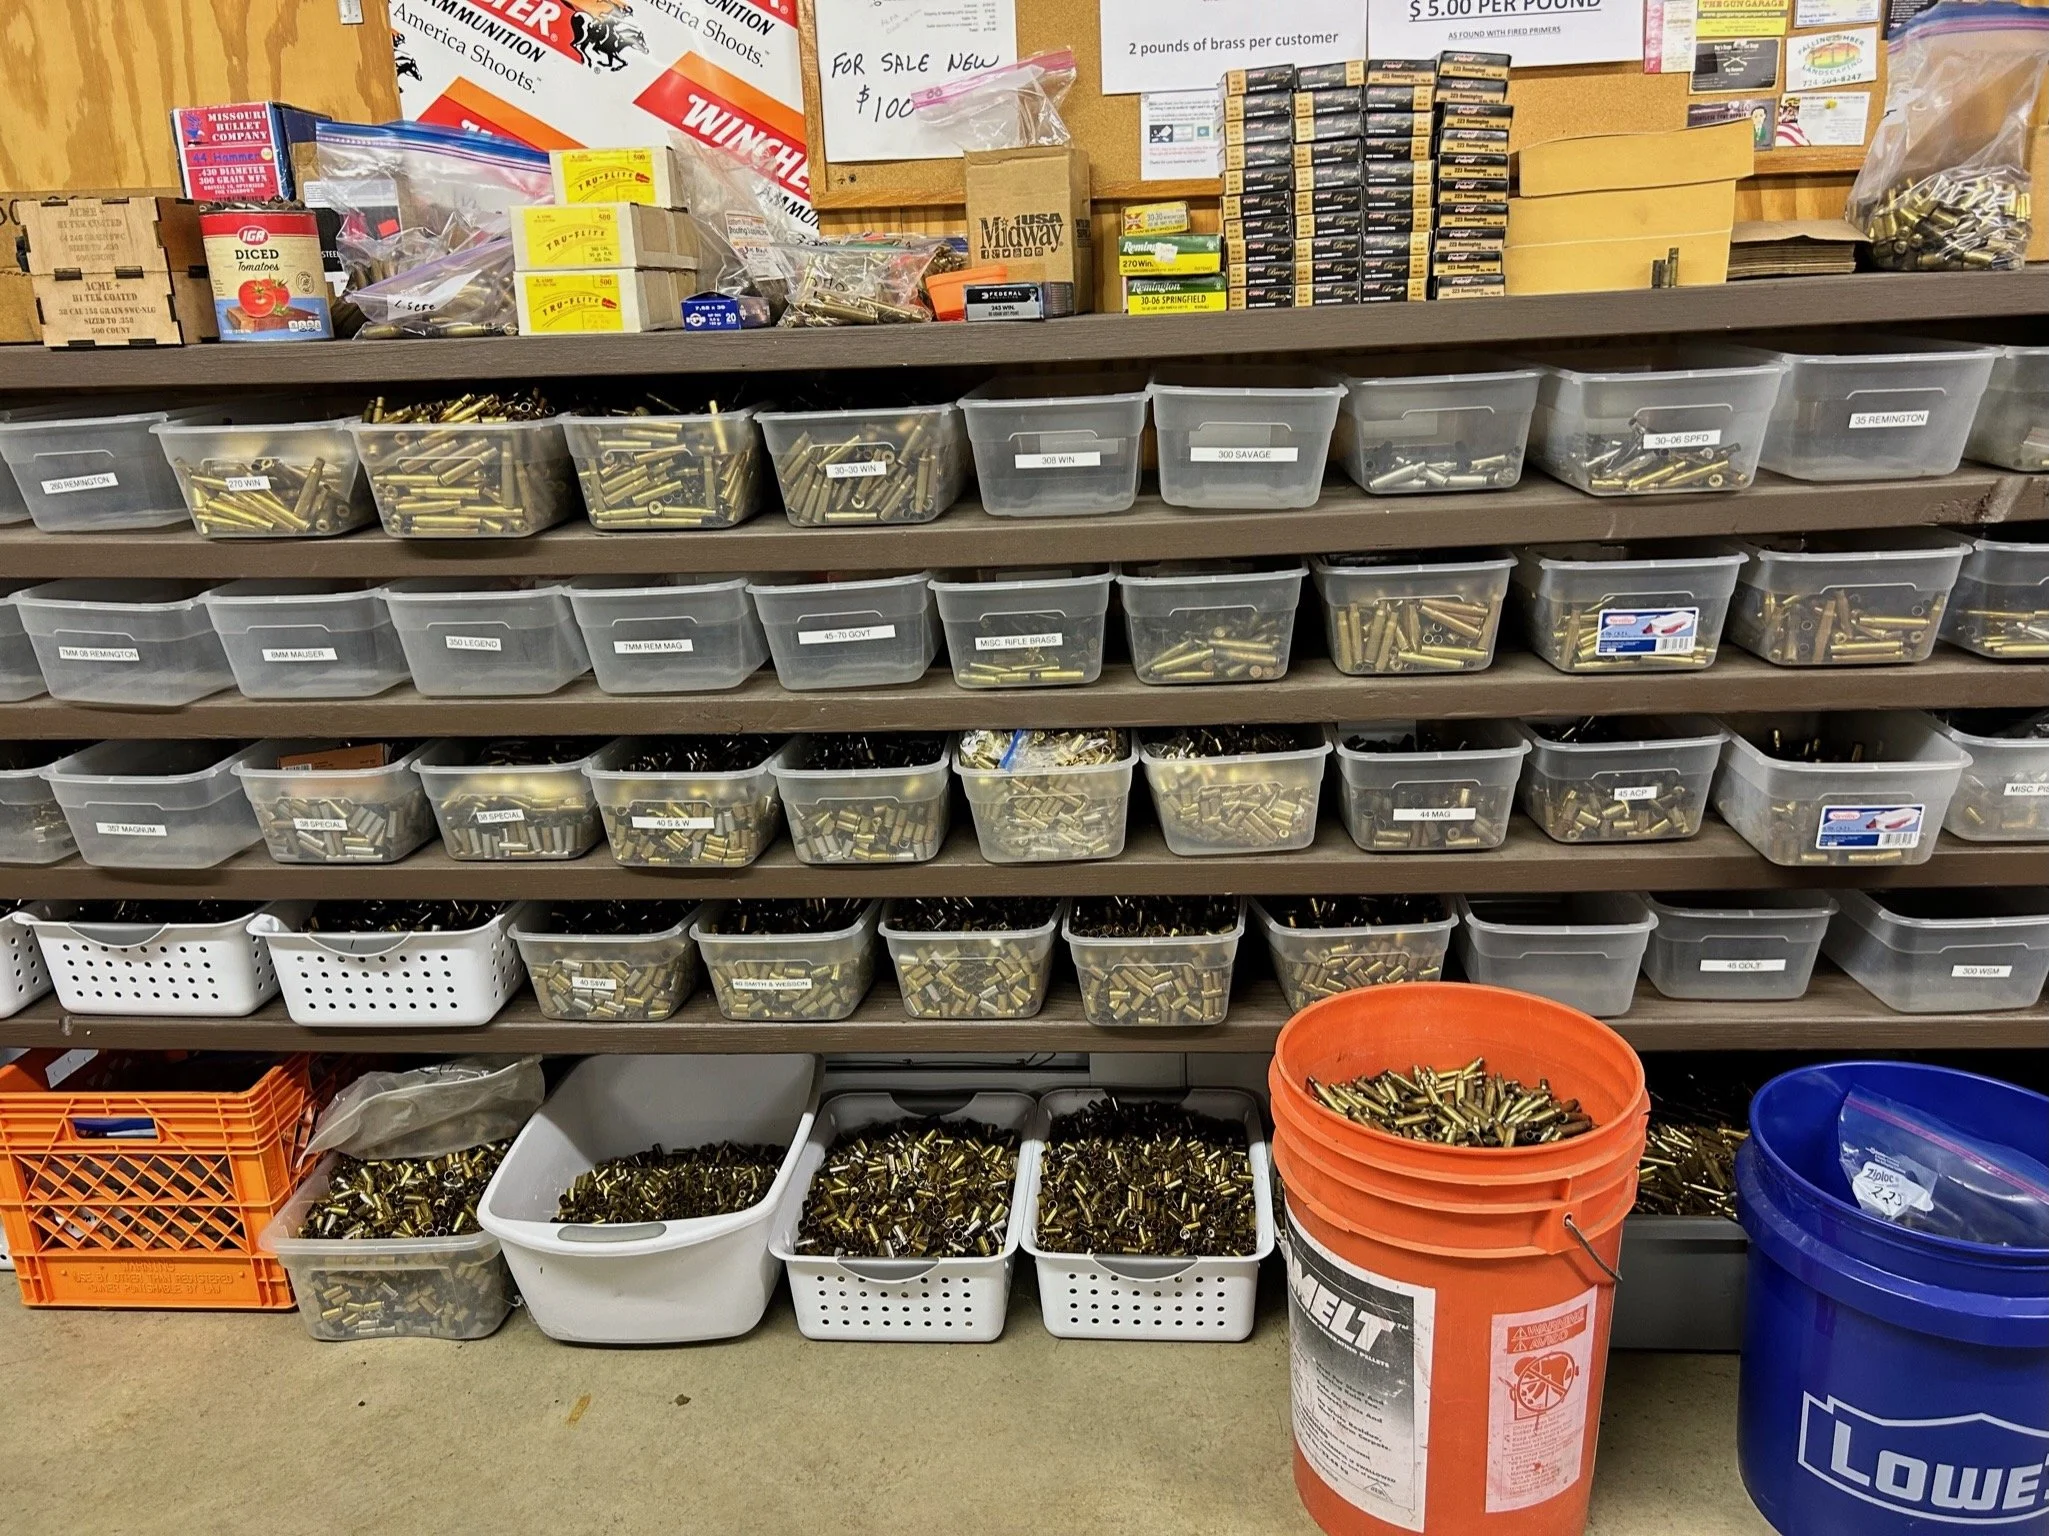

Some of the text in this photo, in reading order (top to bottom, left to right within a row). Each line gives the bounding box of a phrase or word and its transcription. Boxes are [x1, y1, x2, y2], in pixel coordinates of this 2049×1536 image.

[1428, 0, 1472, 16] 5.00
[1478, 0, 1517, 14] PER
[1746, 0, 1784, 8] GARAGE
[423, 0, 546, 62] MMUNITION
[1459, 30, 1485, 38] FOUND
[1487, 28, 1506, 37] WITH
[1507, 27, 1528, 36] FIRED
[1529, 26, 1561, 34] PRIMERS
[394, 3, 536, 94] America Shoots.
[702, 19, 763, 68] Shoots.
[1129, 31, 1339, 57] 2 pounds of brass per customer
[832, 52, 999, 78] FOR SALE NEW
[208, 111, 267, 122] MISSOURI
[216, 121, 260, 131] BULLET
[212, 131, 268, 141] COMPANY
[193, 152, 260, 162] 44 Hammer
[219, 166, 265, 175] DIAMETER
[217, 175, 245, 184] GRAIN
[598, 213, 611, 221] 500
[1015, 212, 1062, 226] USA
[242, 230, 266, 241] IGA
[546, 229, 606, 251] TRU-FLITE
[979, 217, 1064, 253] Midway
[235, 249, 279, 260] DICED
[238, 261, 280, 272] Tomatoes
[84, 282, 113, 291] ACME
[1132, 282, 1180, 294] Remington
[104, 293, 138, 301] COATED
[1141, 294, 1206, 305] 30-06 SPRINGFIELD
[542, 297, 599, 317] TRU-FLITE
[84, 317, 105, 325] SIZED
[106, 317, 117, 325] TO
[725, 312, 737, 323] 20
[106, 326, 130, 334] COUNT
[1855, 414, 1925, 425] 35 REMINGTON
[1654, 433, 1709, 445] 30-06 SPFD
[1218, 449, 1272, 459] 300 SAVAGE
[1041, 455, 1075, 465] 308 WIN
[834, 464, 877, 475] 30-30 WIN
[64, 475, 110, 488] REMINGTON
[228, 478, 261, 489] 270 WIN
[824, 629, 872, 640] 45-70 GOVT
[448, 638, 498, 649] 350 LEGEND
[624, 641, 683, 652] 7MM REM MAG
[980, 635, 1057, 648] MISC. RIFLE BRASS
[61, 648, 137, 660] 7MM 08 REMINGTON
[271, 649, 325, 659] 8MM MAUSER
[1618, 789, 1648, 798] 45 ACP
[2010, 785, 2035, 793] MISC.
[489, 811, 521, 821] SPECIAL
[1432, 810, 1451, 819] MAG
[299, 820, 343, 829] 38 SPECIAL
[667, 819, 673, 827] S
[107, 825, 157, 834] 357 MAGNUM
[1727, 962, 1737, 970] 45
[580, 979, 589, 987] 40
[743, 980, 767, 988] SMITH
[775, 980, 808, 988] WESSON
[1864, 1168, 1894, 1183] Ziploc
[114, 1273, 143, 1284] OTHER
[175, 1273, 233, 1284] REGISTERED
[1527, 1308, 1584, 1336] WARNING
[1830, 1419, 2049, 1512] LOWE
